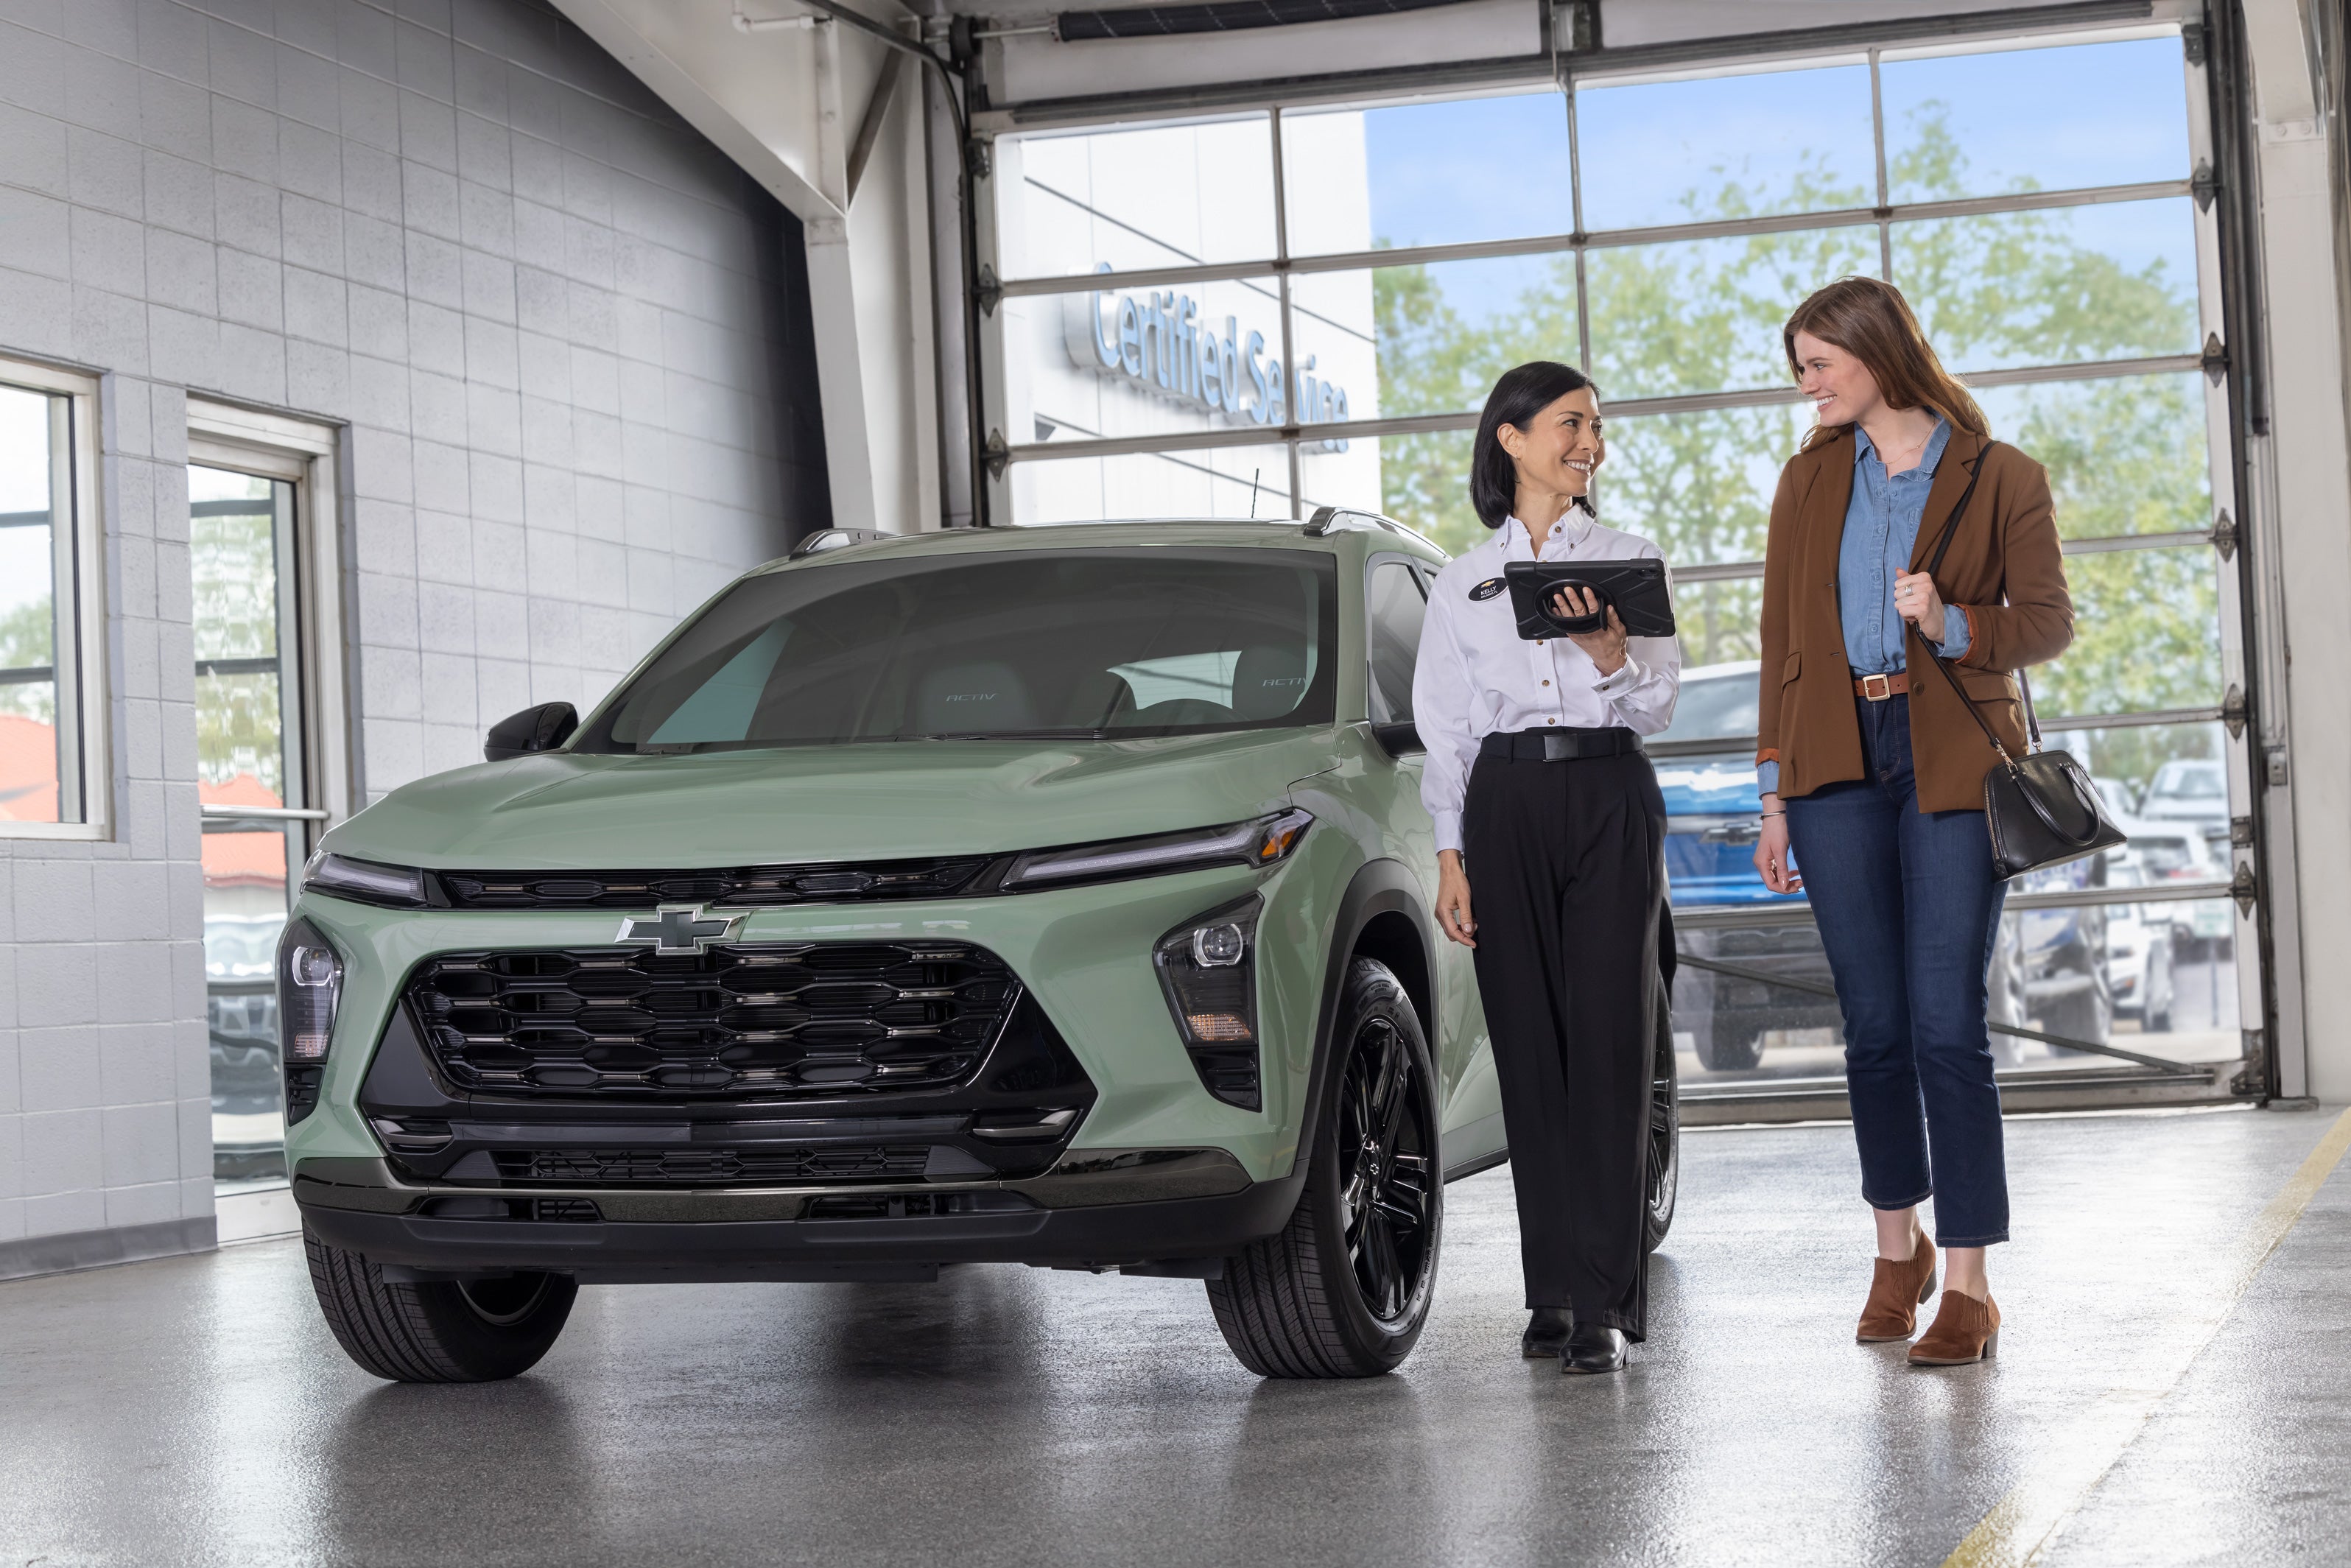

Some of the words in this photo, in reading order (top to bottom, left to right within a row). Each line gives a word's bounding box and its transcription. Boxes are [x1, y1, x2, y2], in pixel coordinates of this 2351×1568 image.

[1094, 261, 1239, 414] Certified
[1248, 329, 1350, 454] Sevice
[1480, 586, 1496, 595] KELLY
[946, 693, 997, 702] ACTIV
